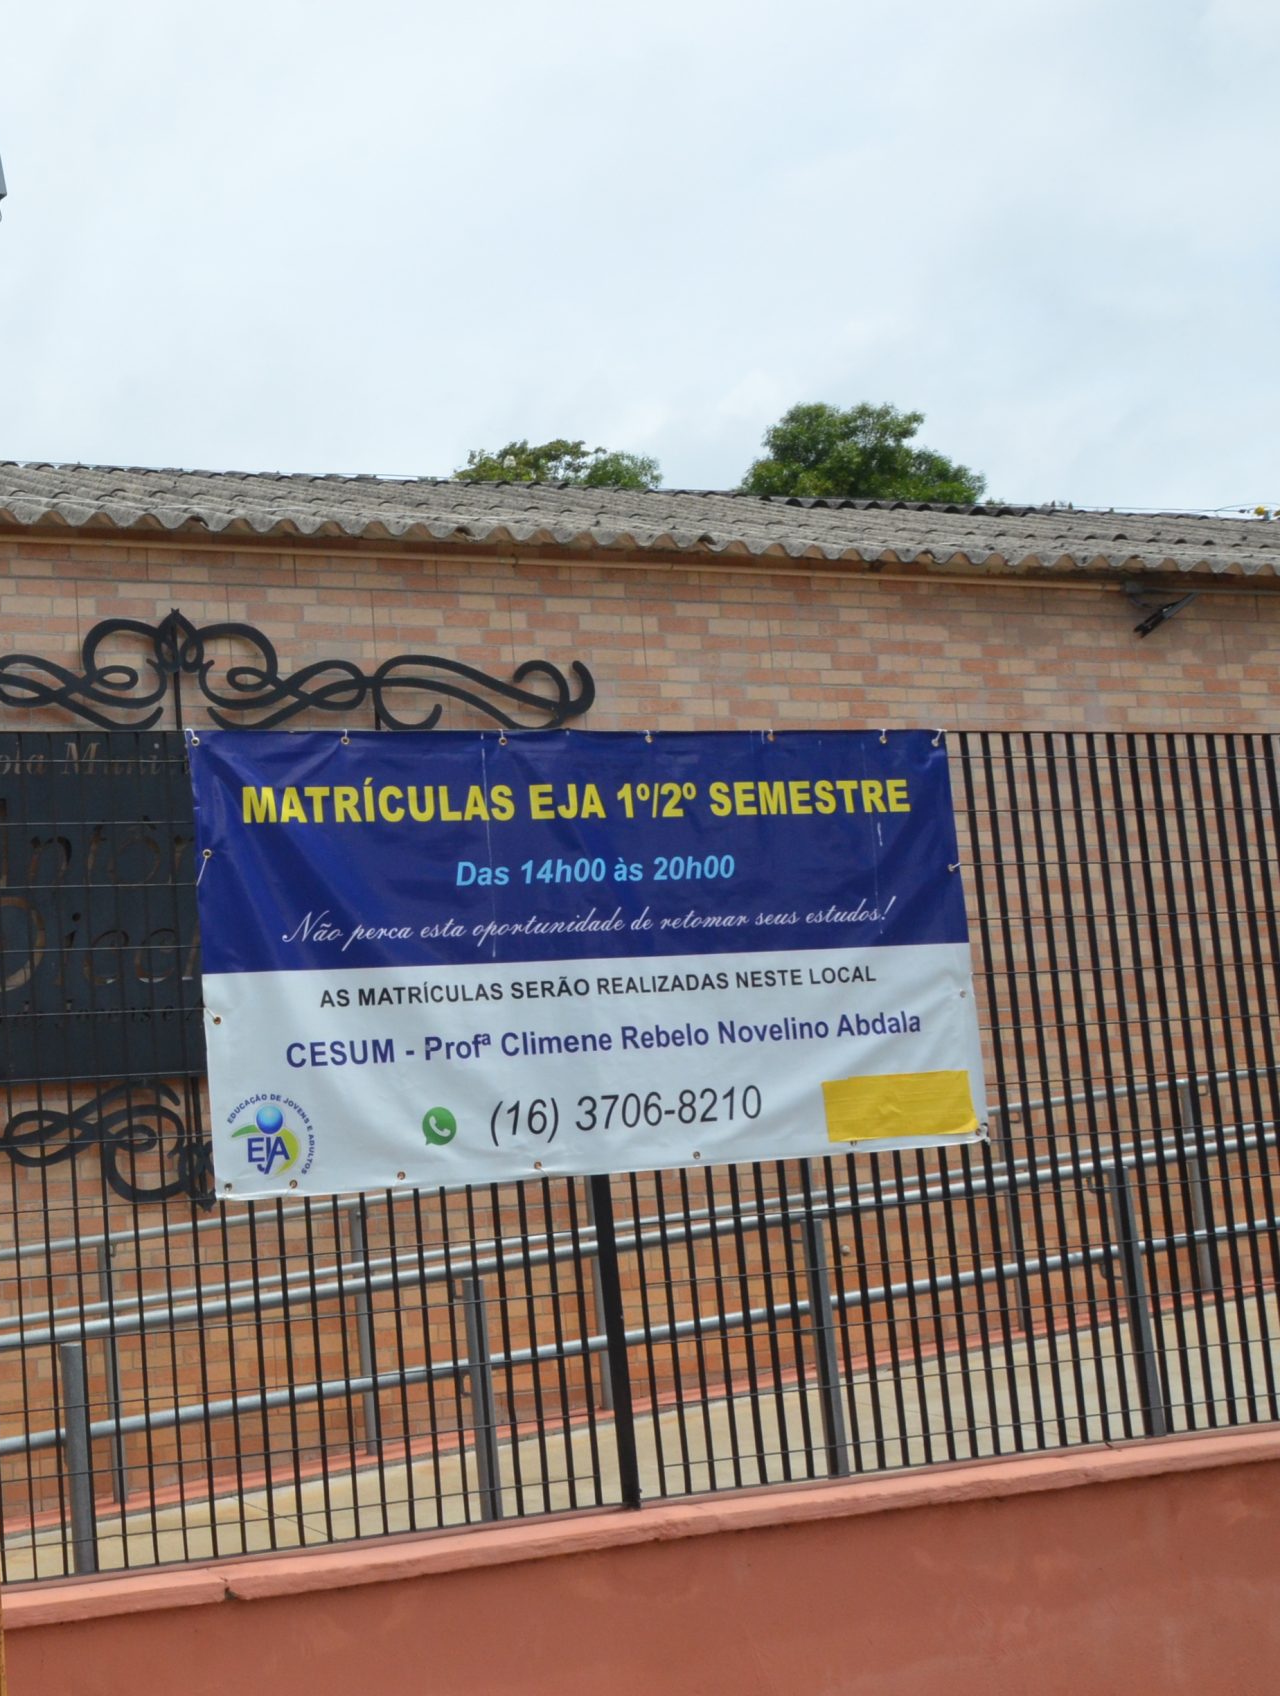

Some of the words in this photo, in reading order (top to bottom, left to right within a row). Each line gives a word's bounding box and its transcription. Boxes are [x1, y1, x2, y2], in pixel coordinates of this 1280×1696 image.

[242, 777, 515, 824] MATRÍCULAS
[528, 783, 607, 819] EJA
[617, 782, 697, 819] 1º/2º
[709, 779, 911, 817] SEMESTRE
[456, 861, 509, 886] Das
[520, 857, 606, 884] 14h00
[614, 857, 643, 881] às
[654, 854, 735, 881] 20h00
[282, 910, 344, 942] Não
[342, 924, 412, 951] perca
[420, 916, 467, 939] esta
[472, 906, 625, 947] oportunidade
[630, 905, 654, 930] de
[660, 909, 750, 929] retomar
[755, 911, 800, 926] seus
[806, 895, 896, 924] estudos!
[320, 989, 350, 1008] AS
[358, 981, 503, 1006] MATRÍCULAS
[511, 976, 590, 1000] SERÃO
[597, 972, 729, 996] REALIZADAS
[736, 968, 803, 989] NESTE
[809, 965, 877, 985] LOCAL
[286, 1038, 395, 1068] CESUM
[424, 1033, 491, 1061] Profª
[501, 1030, 612, 1057] Climene
[621, 1023, 709, 1050] Rebelo
[718, 1015, 829, 1045] Novelino
[837, 1010, 920, 1038] Abdala
[227, 1094, 267, 1124] EDUCAÇÃO
[283, 1098, 310, 1124] JOVENS
[301, 1134, 315, 1174] ADULTOS
[490, 1098, 559, 1146] (16)
[575, 1084, 761, 1132] 3706-8210
[248, 1136, 290, 1175] EJA
